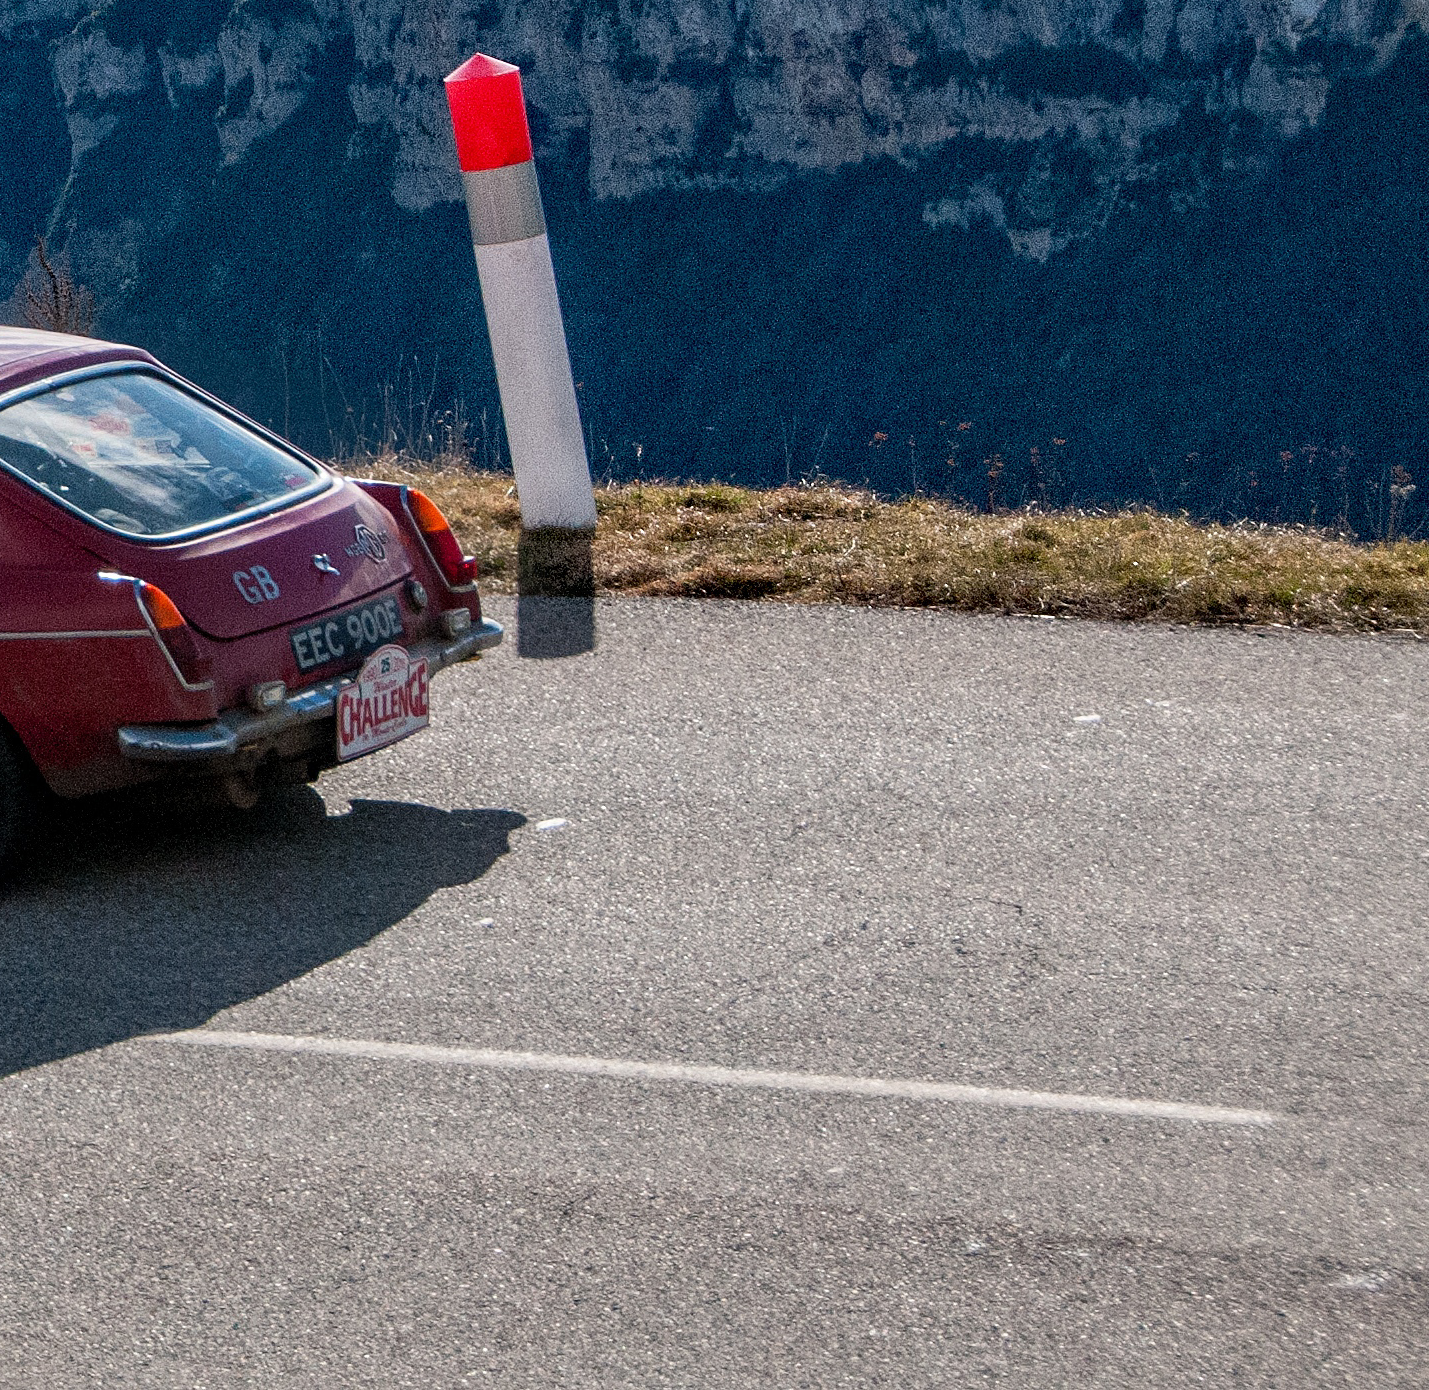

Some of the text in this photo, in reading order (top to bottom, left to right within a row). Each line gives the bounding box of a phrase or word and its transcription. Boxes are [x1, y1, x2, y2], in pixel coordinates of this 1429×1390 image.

[233, 564, 280, 605] GB
[292, 599, 404, 669] EEC 900E
[341, 663, 428, 746] CHALLENGE
